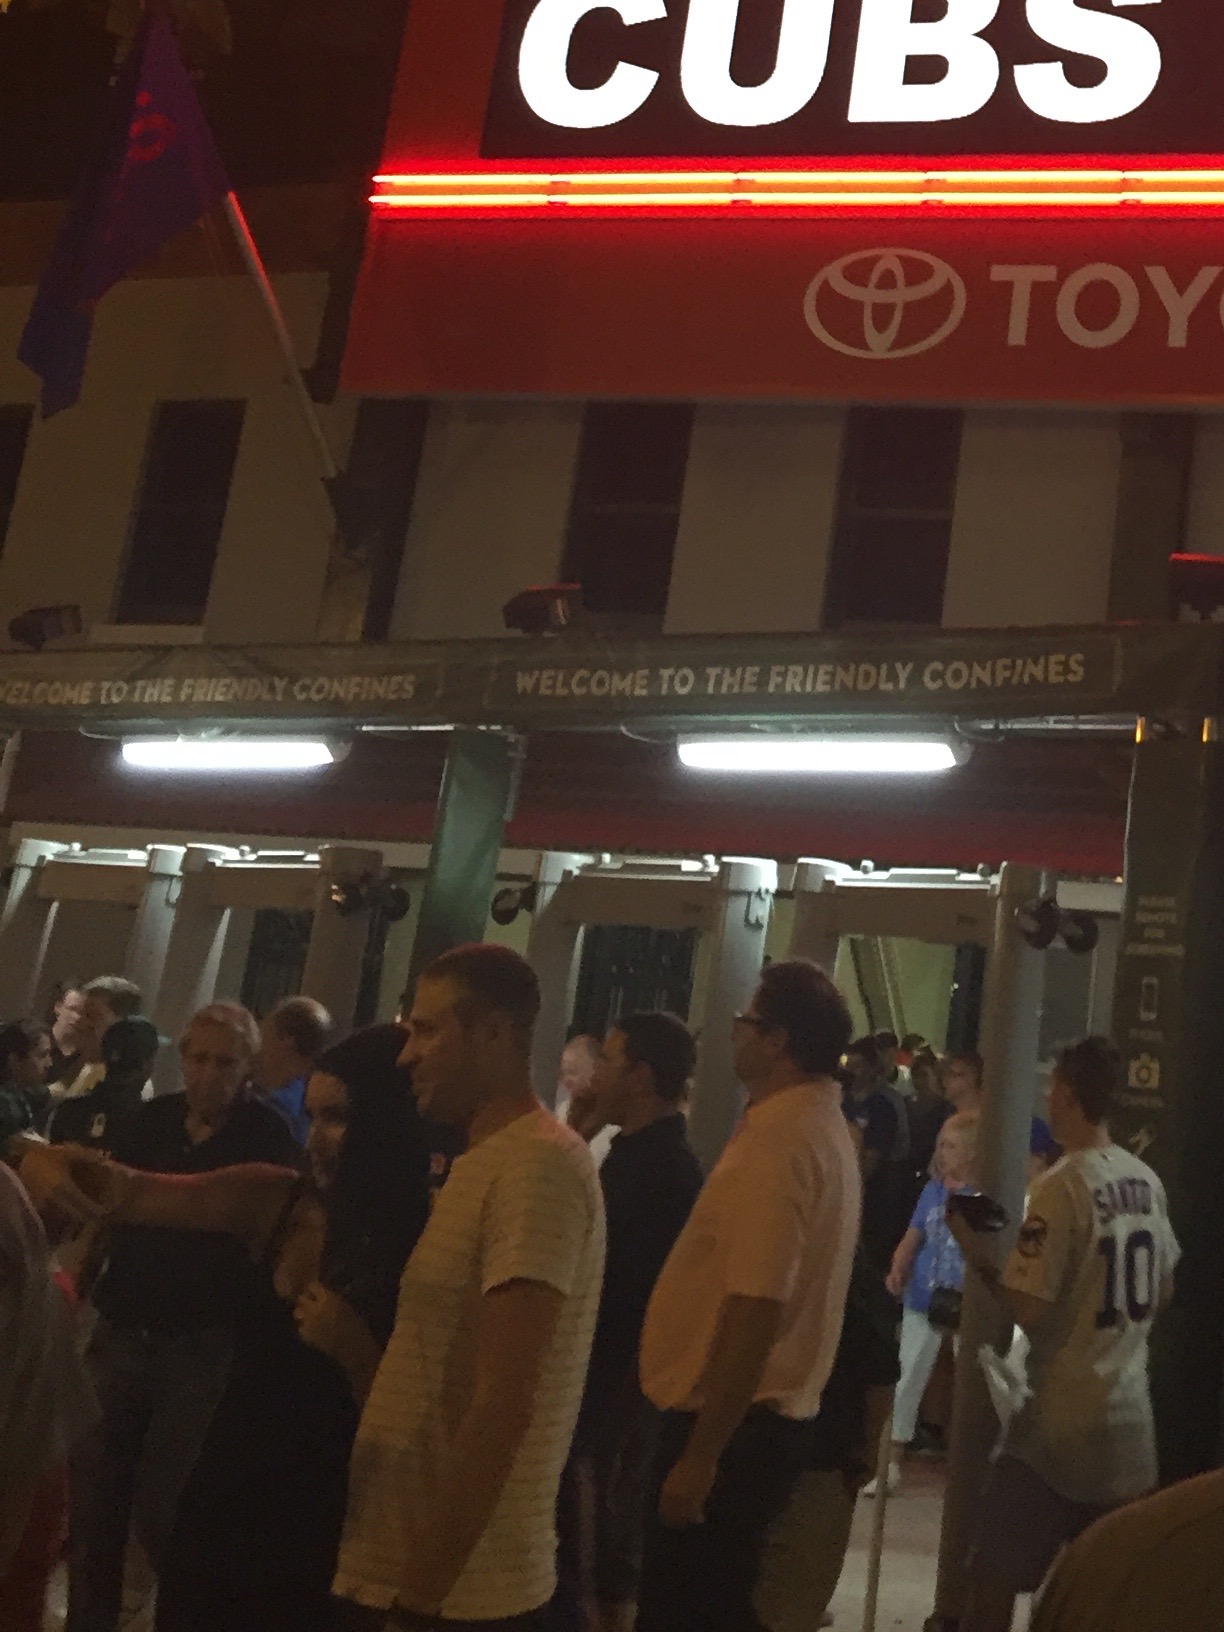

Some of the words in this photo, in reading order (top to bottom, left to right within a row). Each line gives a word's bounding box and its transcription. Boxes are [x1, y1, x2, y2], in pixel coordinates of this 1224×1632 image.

[0, 678, 94, 705] ELCOME
[99, 678, 129, 705] TO
[132, 677, 176, 704] THE
[179, 676, 290, 703] FRIENDLY
[293, 674, 417, 702] CONFINES
[515, 667, 650, 697] WELCOME
[658, 666, 695, 696] TO
[706, 665, 761, 695] THE
[767, 662, 914, 694] FRIENDLY
[922, 652, 1086, 691] CONFINES
[1095, 1229, 1156, 1330] 10
